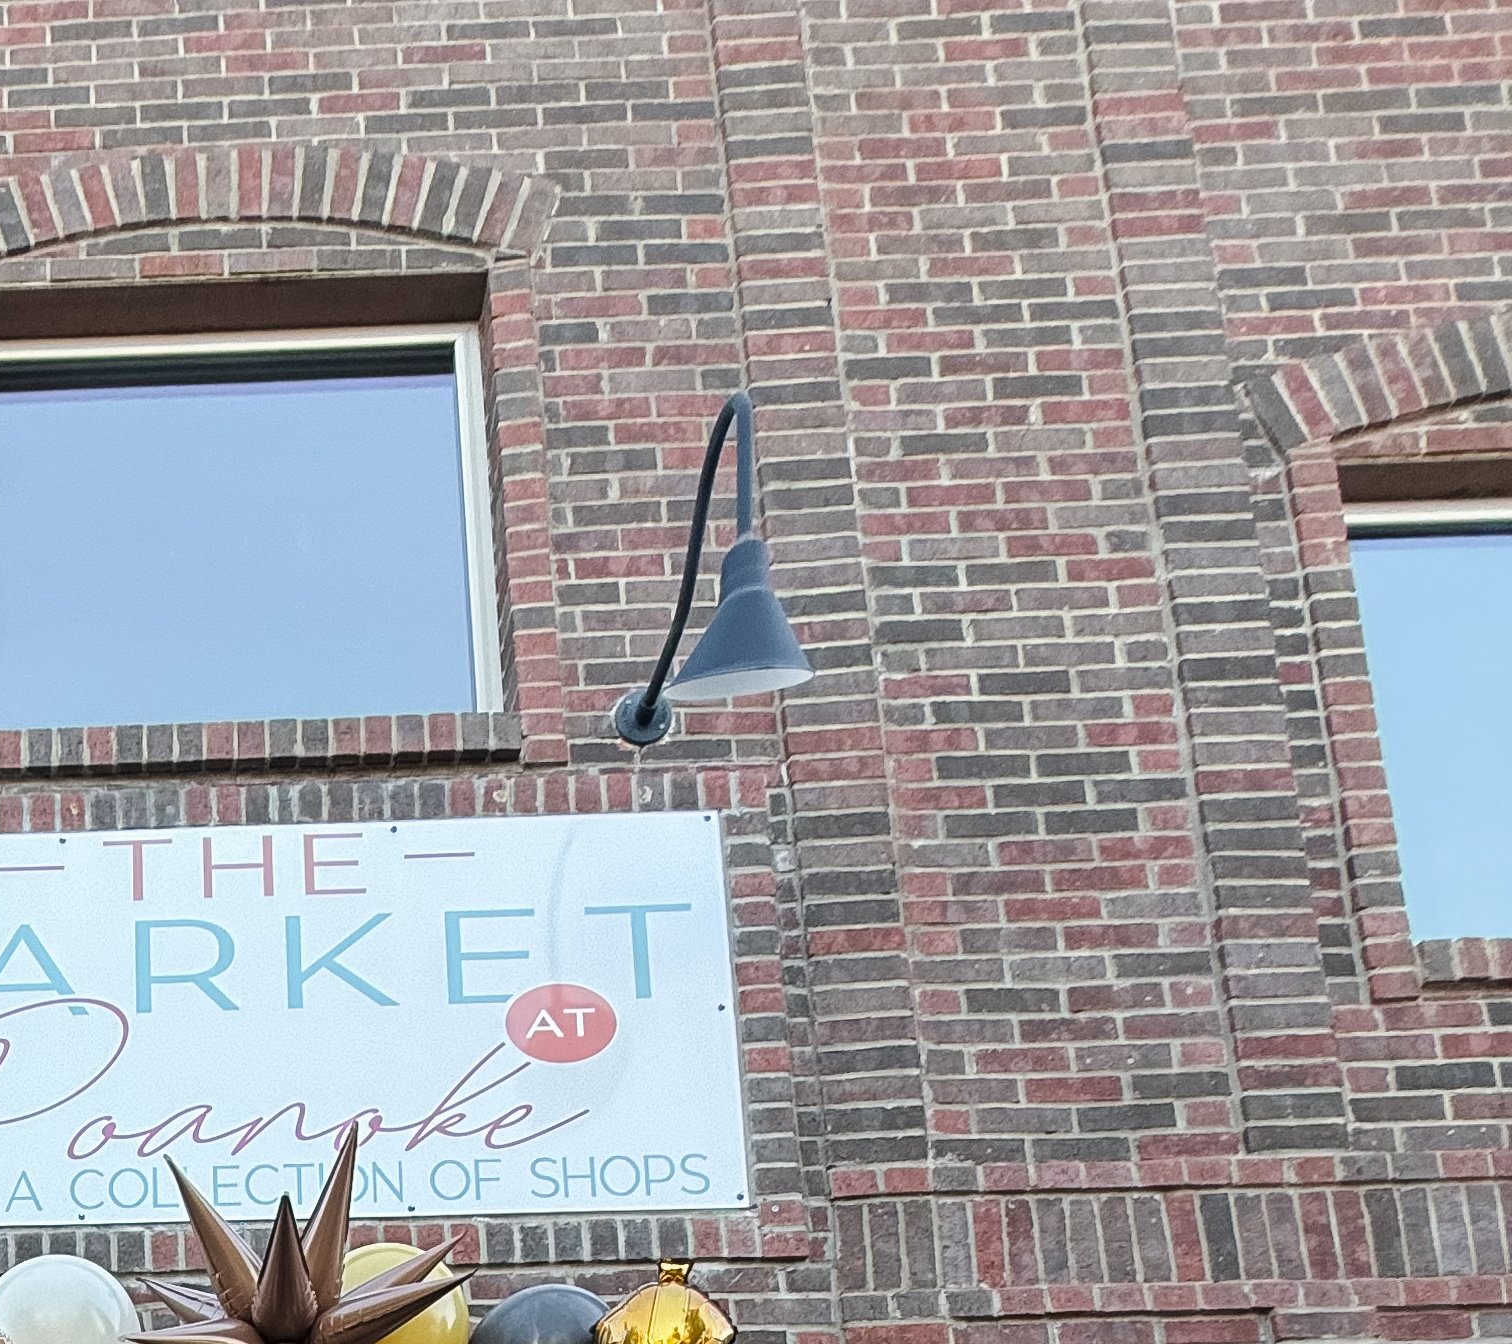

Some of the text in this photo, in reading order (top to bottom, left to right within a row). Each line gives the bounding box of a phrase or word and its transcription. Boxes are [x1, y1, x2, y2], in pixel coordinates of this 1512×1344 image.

[102, 832, 368, 902] THE
[525, 1007, 596, 1040] AT
[4, 1169, 43, 1213] A
[429, 1158, 502, 1201] OF
[530, 1153, 711, 1198] SHOPS
